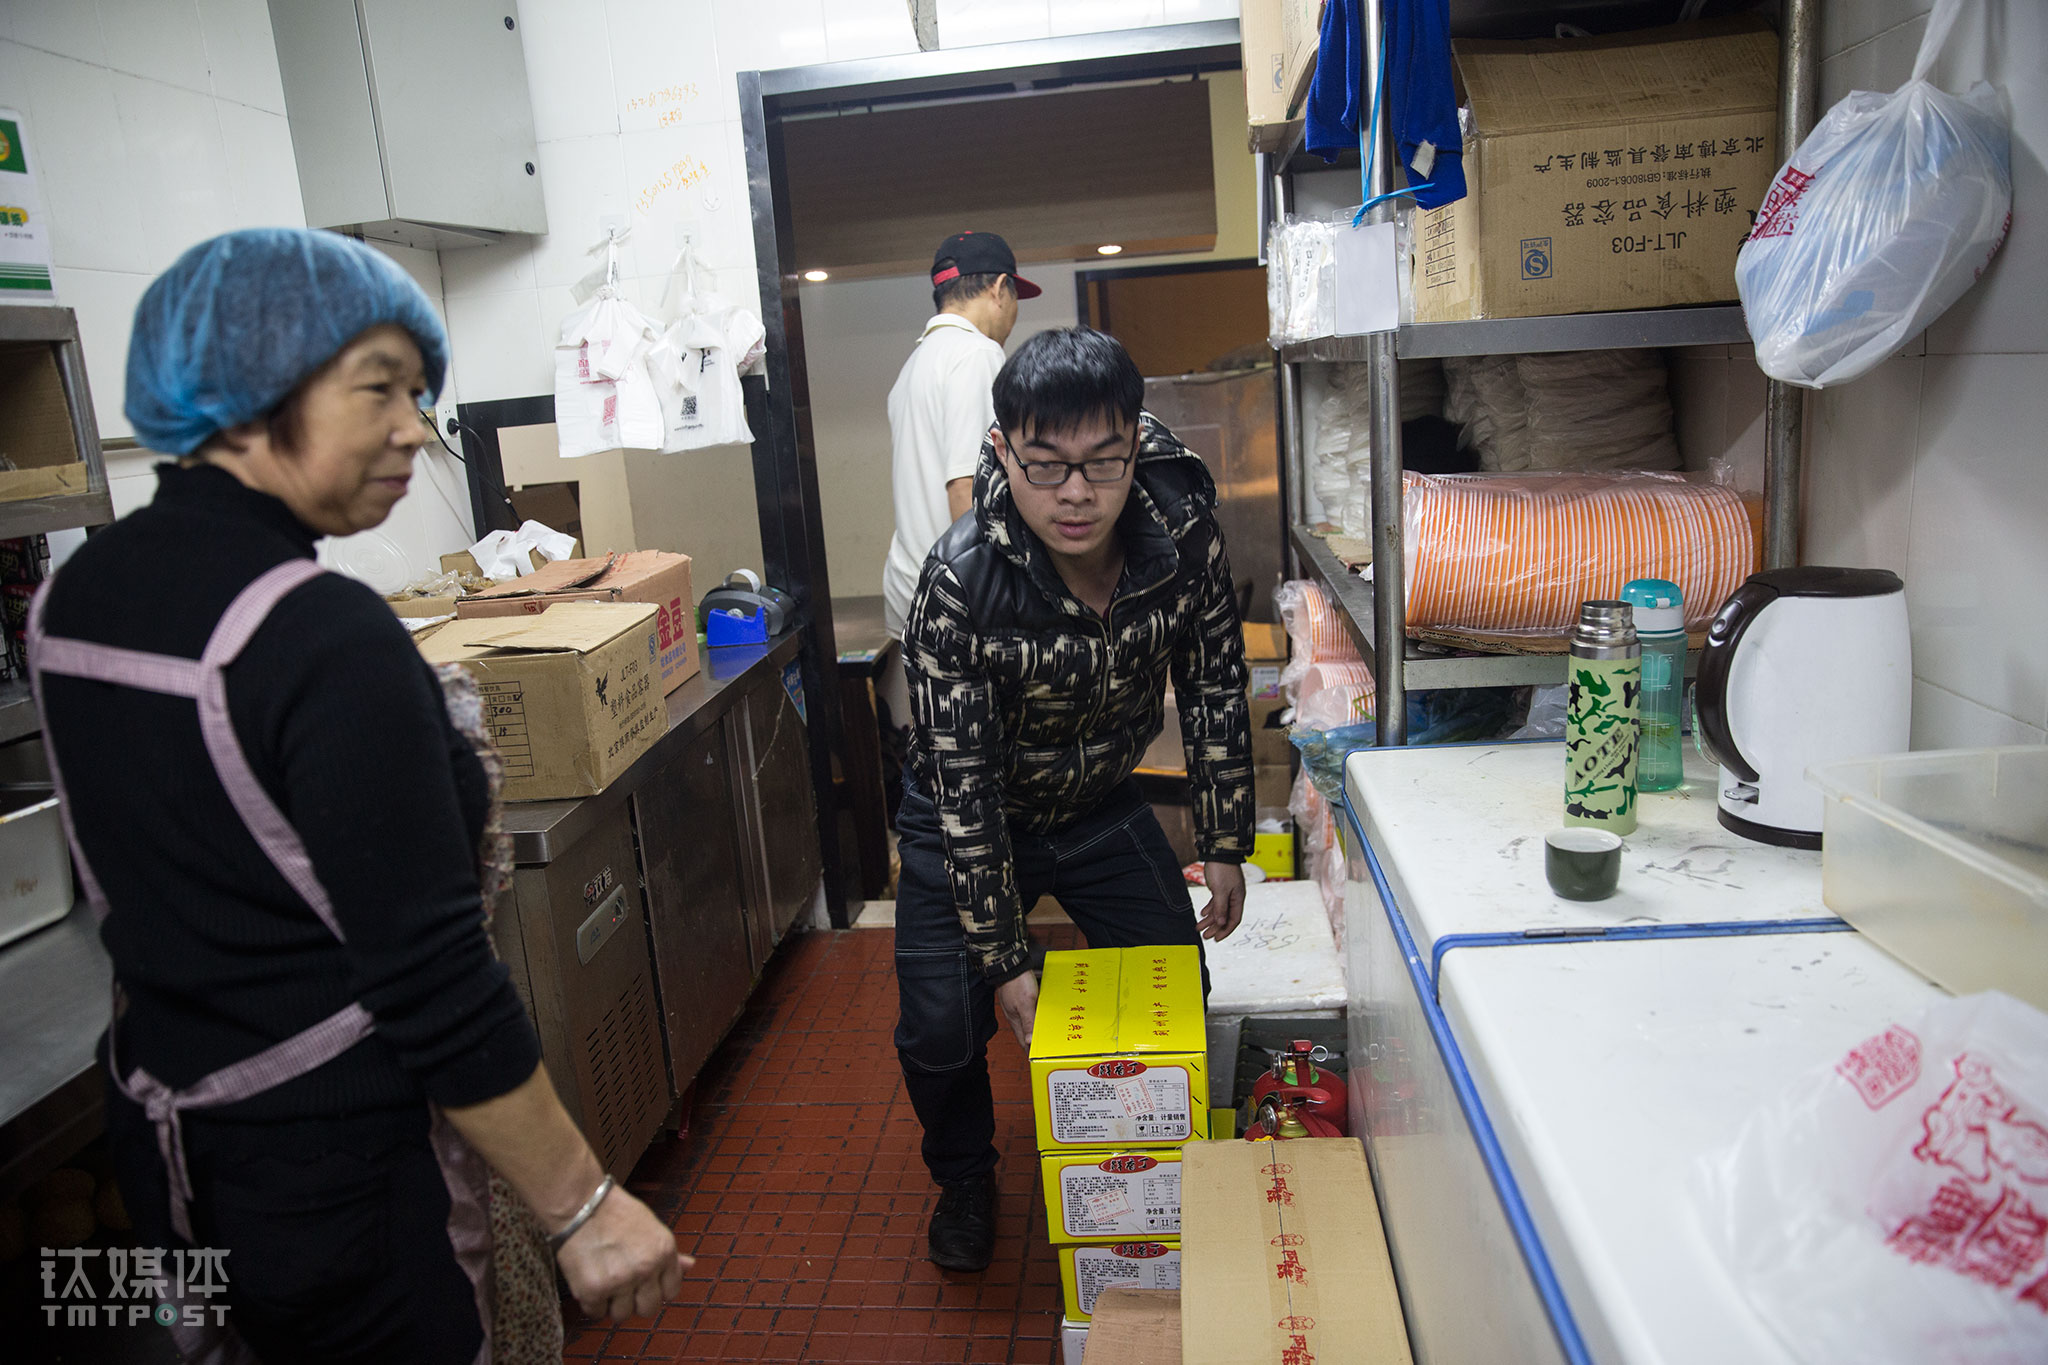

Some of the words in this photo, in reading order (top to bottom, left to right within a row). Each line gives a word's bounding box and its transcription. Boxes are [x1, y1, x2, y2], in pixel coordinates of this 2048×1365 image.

[1533, 135, 1766, 174] 北京博南餐具监制生产
[1560, 186, 1738, 228] 塑料食品容器
[1611, 230, 1688, 254] JLT-F03
[610, 673, 650, 720] 塑料食品容器
